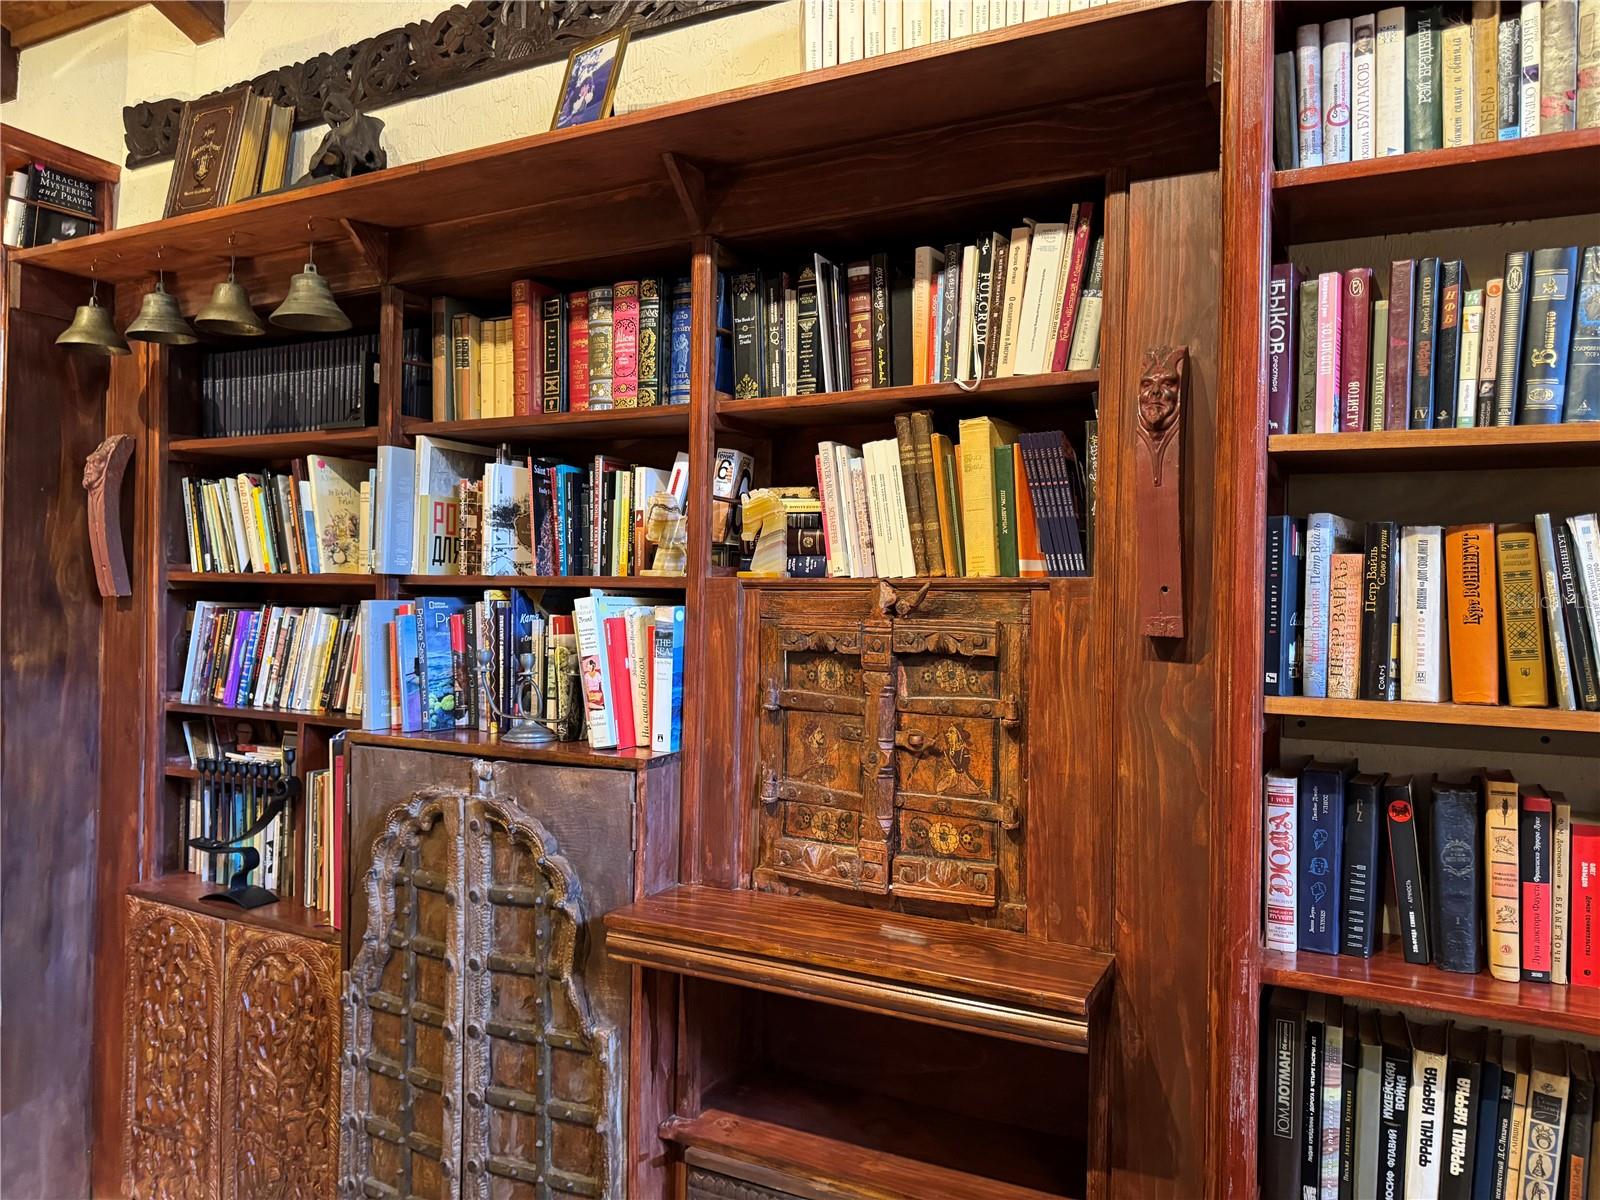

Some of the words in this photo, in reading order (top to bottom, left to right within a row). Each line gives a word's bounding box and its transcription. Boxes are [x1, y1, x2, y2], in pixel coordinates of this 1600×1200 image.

[1417, 18, 1434, 76] БРЭДБЕРИ
[1523, 18, 1536, 63] БЫКОВ
[1357, 62, 1371, 129] БУЛГАКОВ
[1481, 86, 1495, 141] БАБЕЛЬ
[40, 169, 93, 193] MIRACLES,
[40, 177, 93, 201] MYSTERIES,
[38, 188, 57, 197] and
[60, 192, 93, 208] PRAYER
[944, 278, 957, 301] BEING
[1422, 276, 1432, 307] БИТОВ
[976, 272, 991, 346] FULCRUM
[1055, 302, 1063, 321] DAVID
[1421, 308, 1432, 335] Андрей
[1050, 321, 1058, 341] DUBAL
[1374, 362, 1386, 406] БУЦЦАТИ
[1347, 381, 1361, 428] А.Г.БИТОВ
[1373, 407, 1384, 432] ДИНО
[718, 459, 732, 480] 6
[821, 448, 831, 480] FOREVER
[824, 480, 834, 502] MUSIC
[828, 507, 840, 545] SCHAEFFER
[1310, 522, 1323, 554] Вайль
[1380, 529, 1391, 552] пути
[1310, 554, 1324, 584] Петр
[1366, 545, 1379, 579] Вайль
[1377, 560, 1387, 586] Слово
[1462, 532, 1480, 598] ВОННЕГУТ
[1330, 560, 1348, 623] ВАЙЛЬ
[1365, 582, 1379, 613] Петр
[416, 608, 425, 641] Pristine
[1463, 598, 1484, 625] Курт
[417, 642, 426, 664] Seas
[655, 639, 672, 647] THE
[1331, 627, 1346, 677] ПЕТР
[640, 702, 649, 726] сцене
[641, 726, 650, 739] На
[1268, 811, 1294, 897] ДЮМА
[1555, 838, 1564, 878] Достоевский
[1405, 879, 1413, 904] АЛЧНОСТЬ
[1532, 885, 1544, 913] Фауста
[1554, 896, 1563, 931] БЕЛЫЕ
[1553, 935, 1562, 963] НОЧИ
[1309, 1047, 1318, 1067] ТЫСЯЧИ
[1277, 1051, 1292, 1106] ЛОТМАН
[1309, 1068, 1317, 1087] ЧЕТЫРЕ
[1382, 1061, 1397, 1121] ИУДЕЙСКАЯ
[1394, 1075, 1407, 1111] ВОЙНА
[1420, 1067, 1438, 1115] КАФКА
[1308, 1092, 1316, 1113] ДОРОГА
[1344, 1090, 1353, 1123] Кузнецова
[1453, 1077, 1471, 1126] КАФКА
[1343, 1127, 1351, 1157] Анатолия
[1387, 1129, 1398, 1168] ФЛАВИЙ
[1418, 1119, 1435, 1167] ФРАНЦ
[1449, 1129, 1468, 1176] ФРАНЦ
[1342, 1161, 1350, 1182] Письма
[1494, 1161, 1505, 1200] неизвестный
